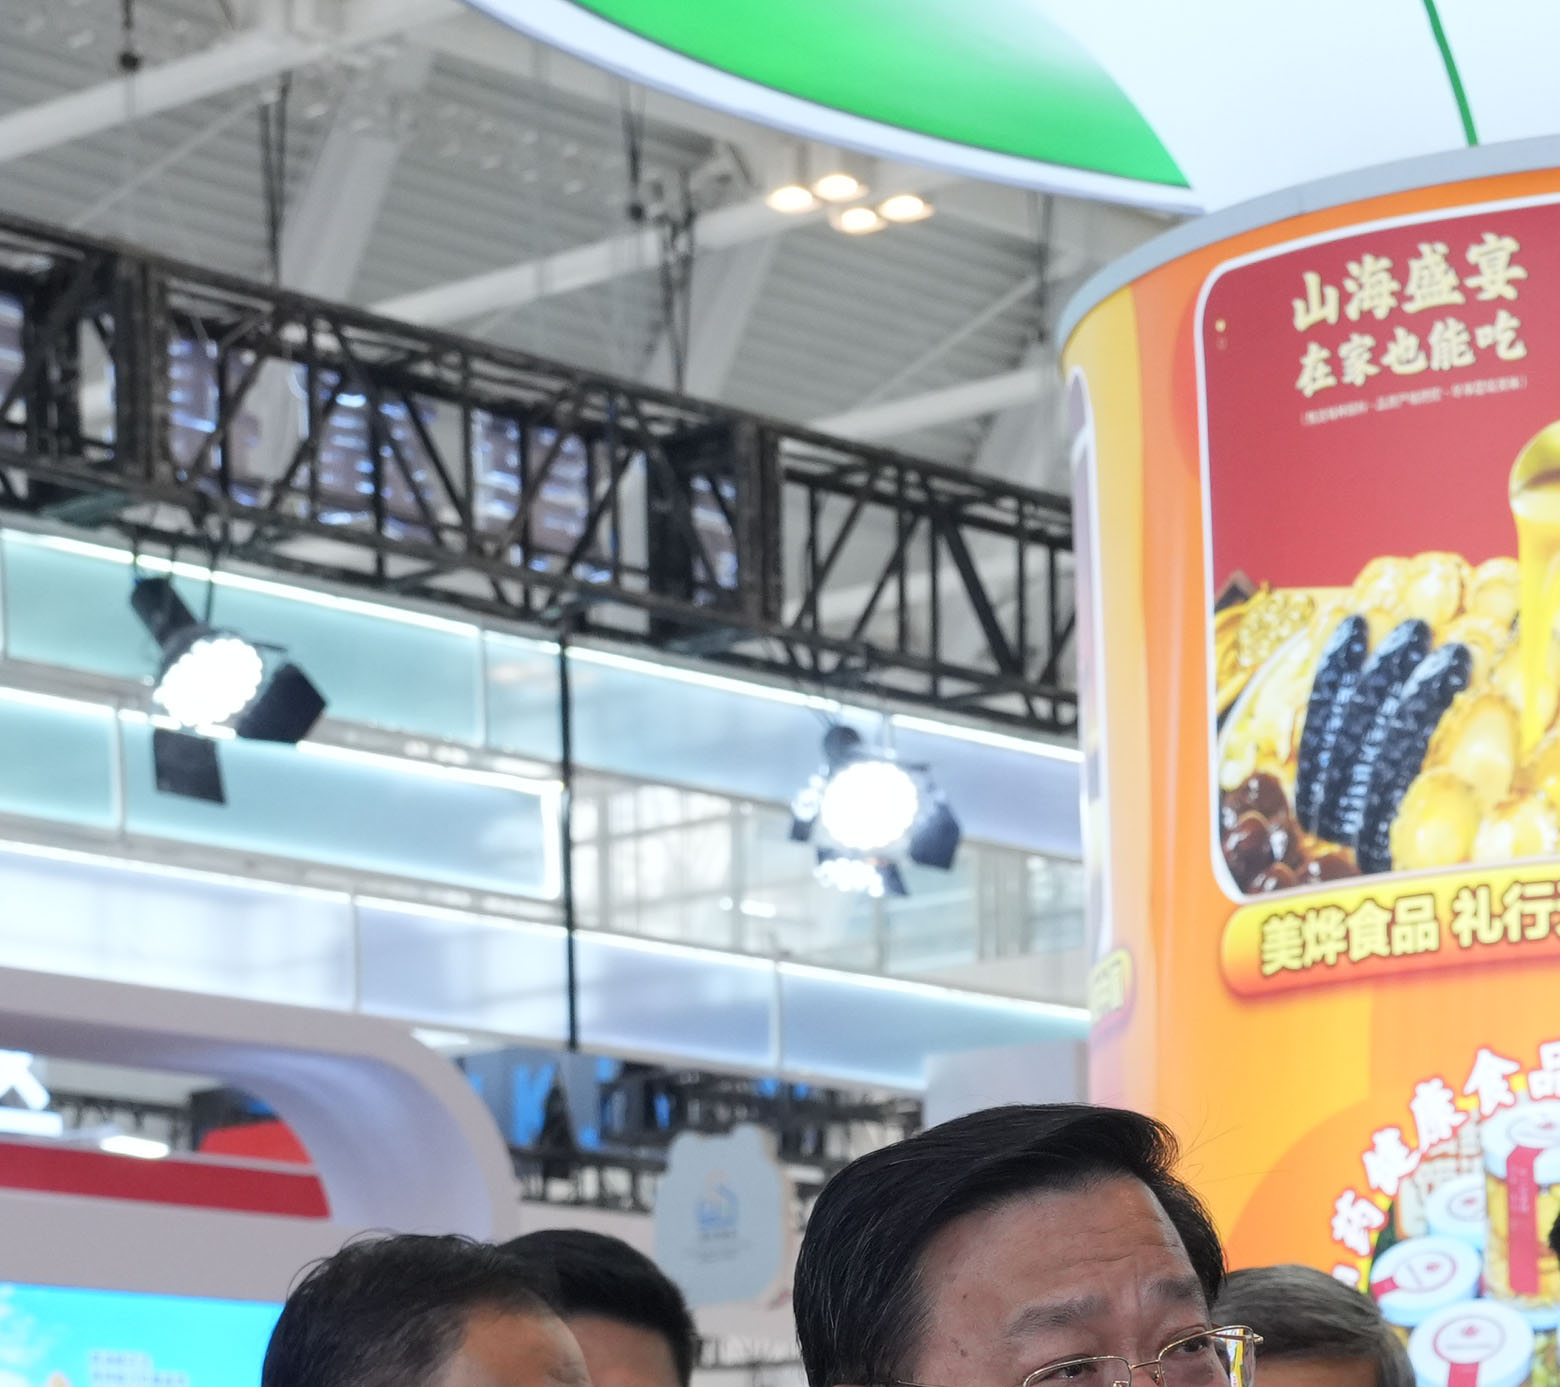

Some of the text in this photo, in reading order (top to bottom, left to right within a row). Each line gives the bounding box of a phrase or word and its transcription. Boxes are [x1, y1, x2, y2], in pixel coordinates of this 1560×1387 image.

[1291, 231, 1528, 332] 山海盛宴
[1295, 308, 1528, 399] 在家也能吃
